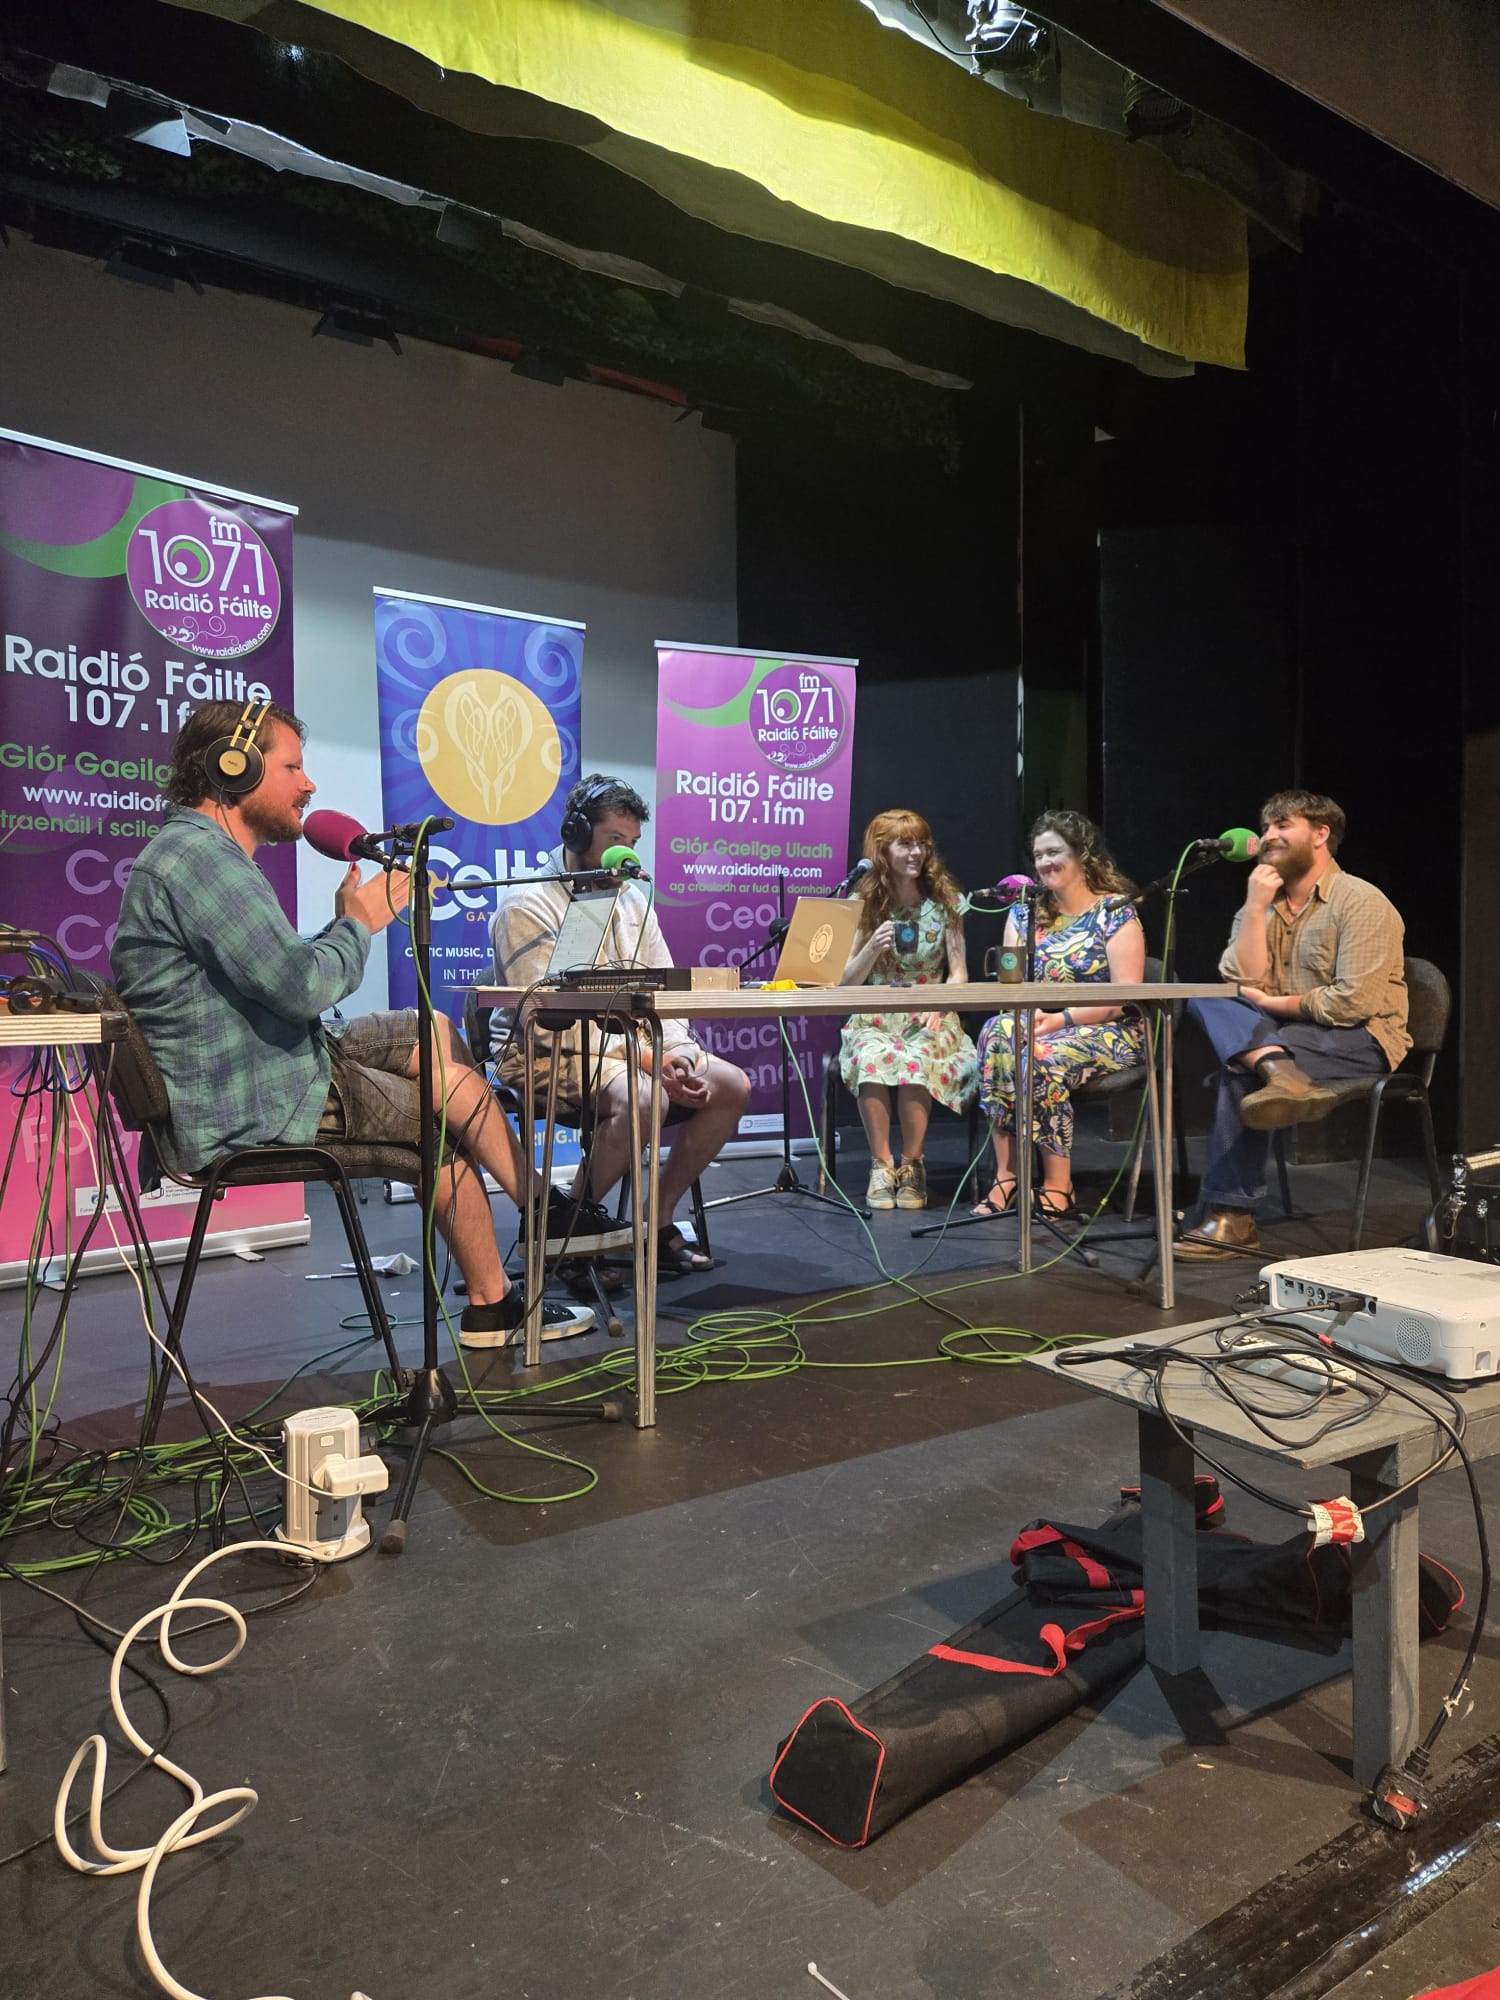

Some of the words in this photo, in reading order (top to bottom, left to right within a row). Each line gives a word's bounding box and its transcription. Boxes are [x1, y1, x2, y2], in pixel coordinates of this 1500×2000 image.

[209, 516, 241, 541] fm
[145, 589, 213, 614] Raidió
[219, 595, 272, 619] Fáilte
[192, 622, 272, 657] www.raidiofailte.com
[5, 634, 150, 692] Raidió
[165, 662, 272, 706] Fáilte
[799, 673, 820, 688] fm
[64, 686, 195, 733] 107.1f
[758, 727, 799, 742] Raidió
[802, 725, 838, 740] Fáilte
[0, 743, 66, 772] Glór
[75, 751, 173, 788] Gaeilg
[676, 769, 759, 798] Raidió
[768, 773, 833, 801] Fáilte
[22, 786, 168, 812] www.raidiof
[709, 798, 804, 825] 107.1fm
[0, 809, 91, 834] traenáil
[98, 817, 103, 835] i
[110, 820, 161, 838] scile
[670, 837, 708, 854] Glór
[713, 838, 781, 860] Gaeilge
[786, 841, 832, 859] Uladh
[683, 863, 822, 878] www.raidiofailte.com
[669, 881, 685, 894] ag
[739, 884, 750, 893] ar
[752, 883, 769, 893] fud
[706, 896, 781, 932] Ceol
[445, 947, 484, 959] MUSIC,
[699, 940, 780, 969] Cain
[443, 969, 456, 980] IN
